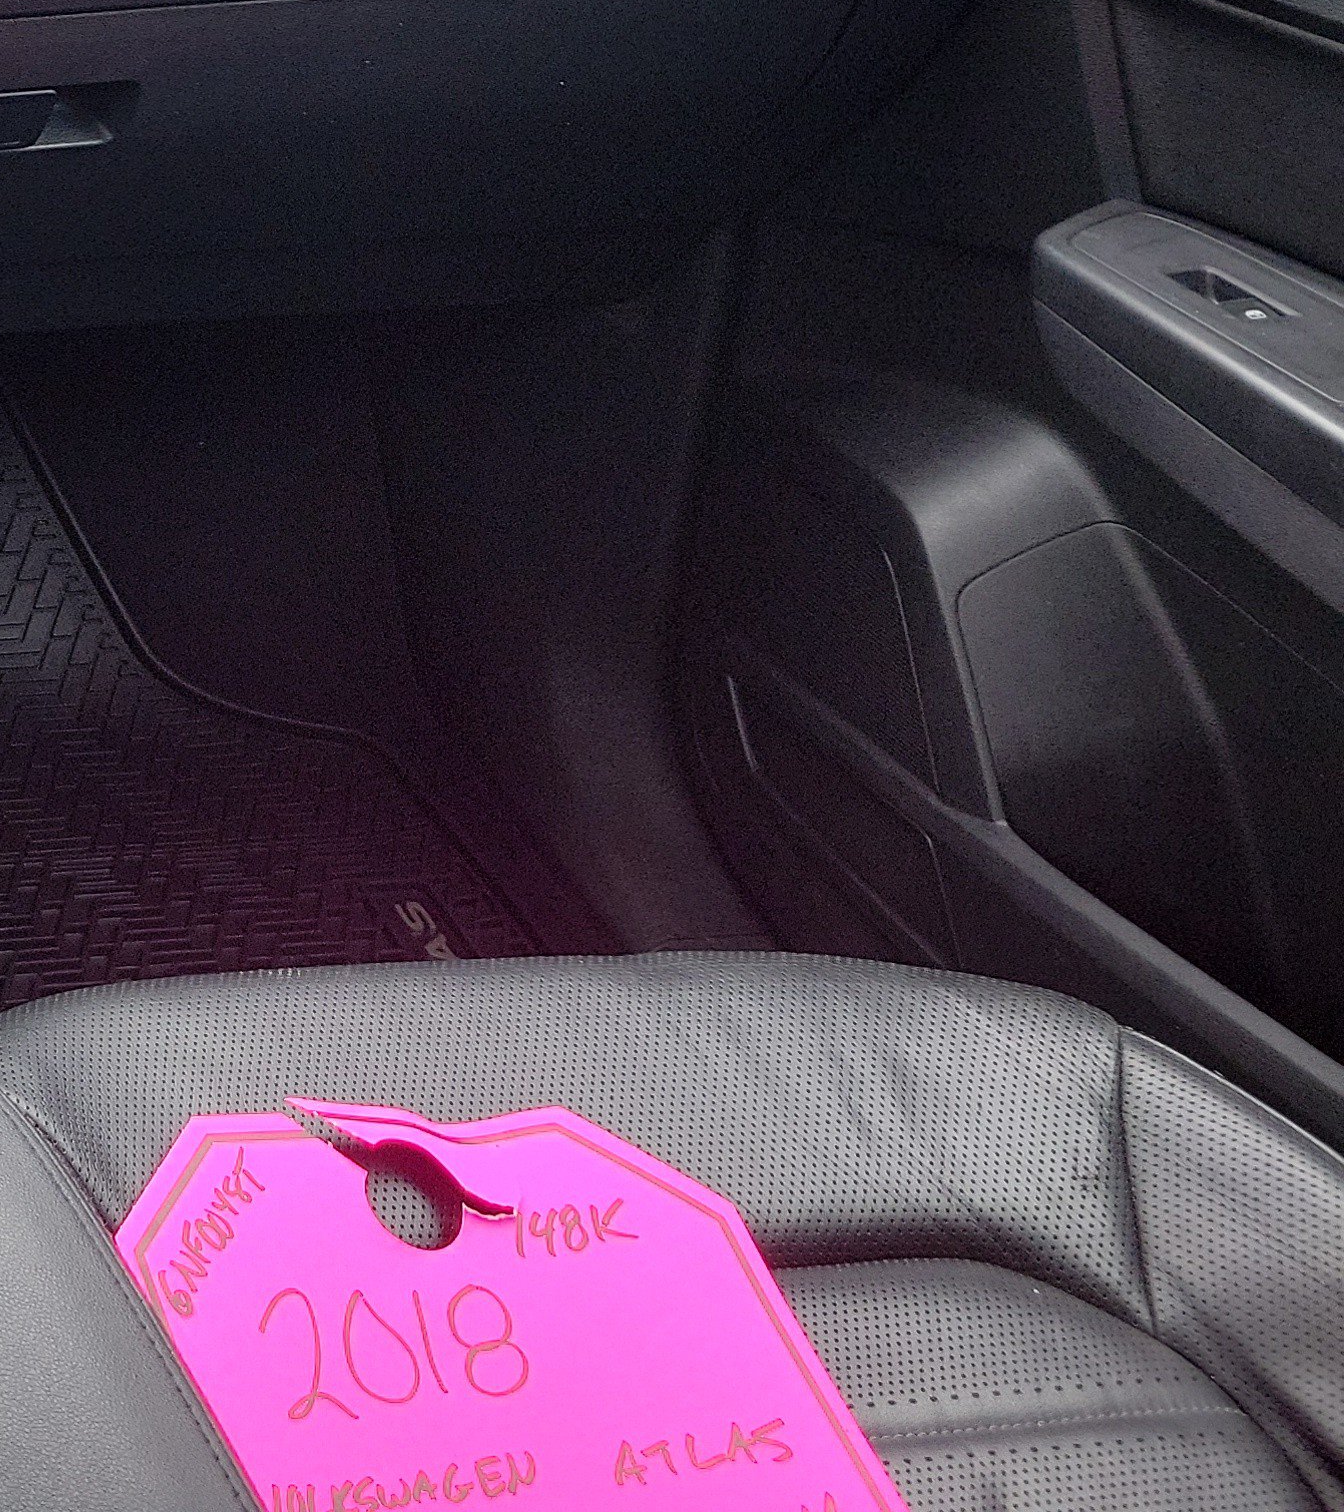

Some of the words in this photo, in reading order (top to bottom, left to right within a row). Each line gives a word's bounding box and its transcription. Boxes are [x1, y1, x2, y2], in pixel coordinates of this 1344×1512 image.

[515, 1198, 639, 1257] 148K
[259, 1283, 530, 1421] 2018
[615, 1418, 794, 1486] ATLAS
